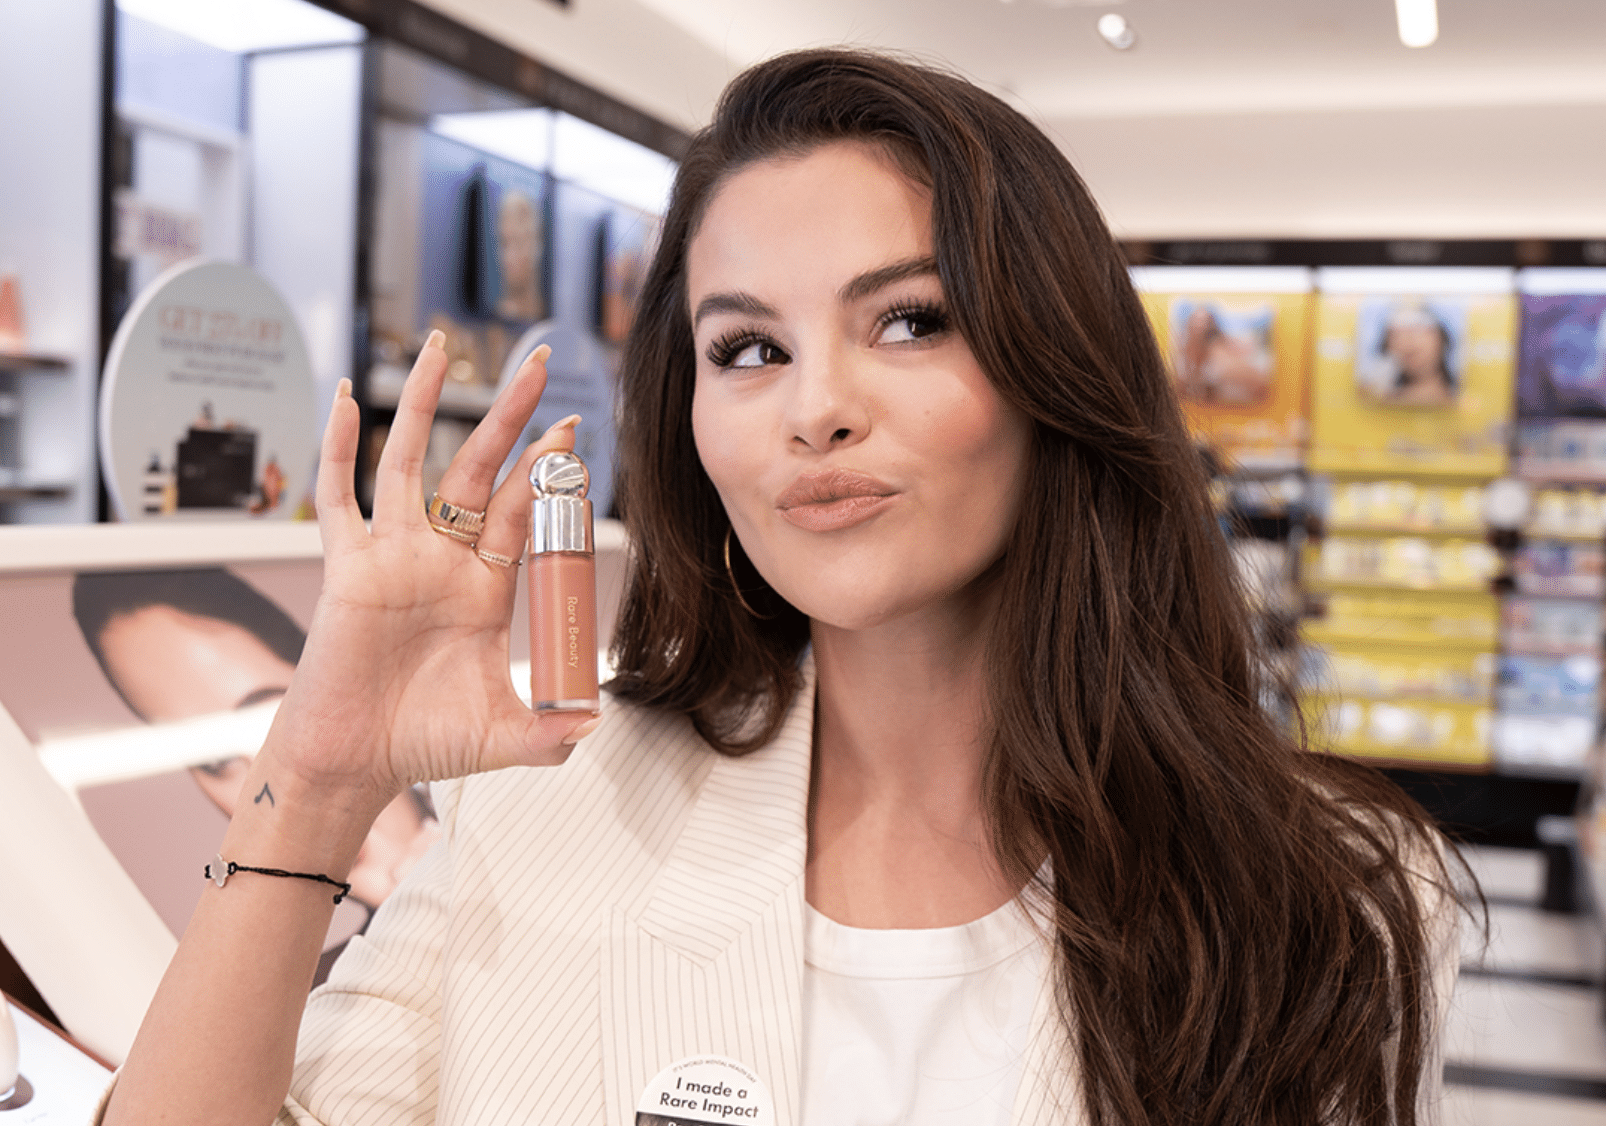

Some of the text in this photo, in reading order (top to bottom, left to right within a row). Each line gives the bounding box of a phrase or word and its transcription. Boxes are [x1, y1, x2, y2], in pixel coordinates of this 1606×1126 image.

[567, 596, 580, 668] Rare Beauty
[705, 1059, 727, 1067] MENTAL
[728, 1063, 747, 1076] HEALTH
[676, 1077, 748, 1099] I made a
[659, 1091, 759, 1118] Rare Impact
